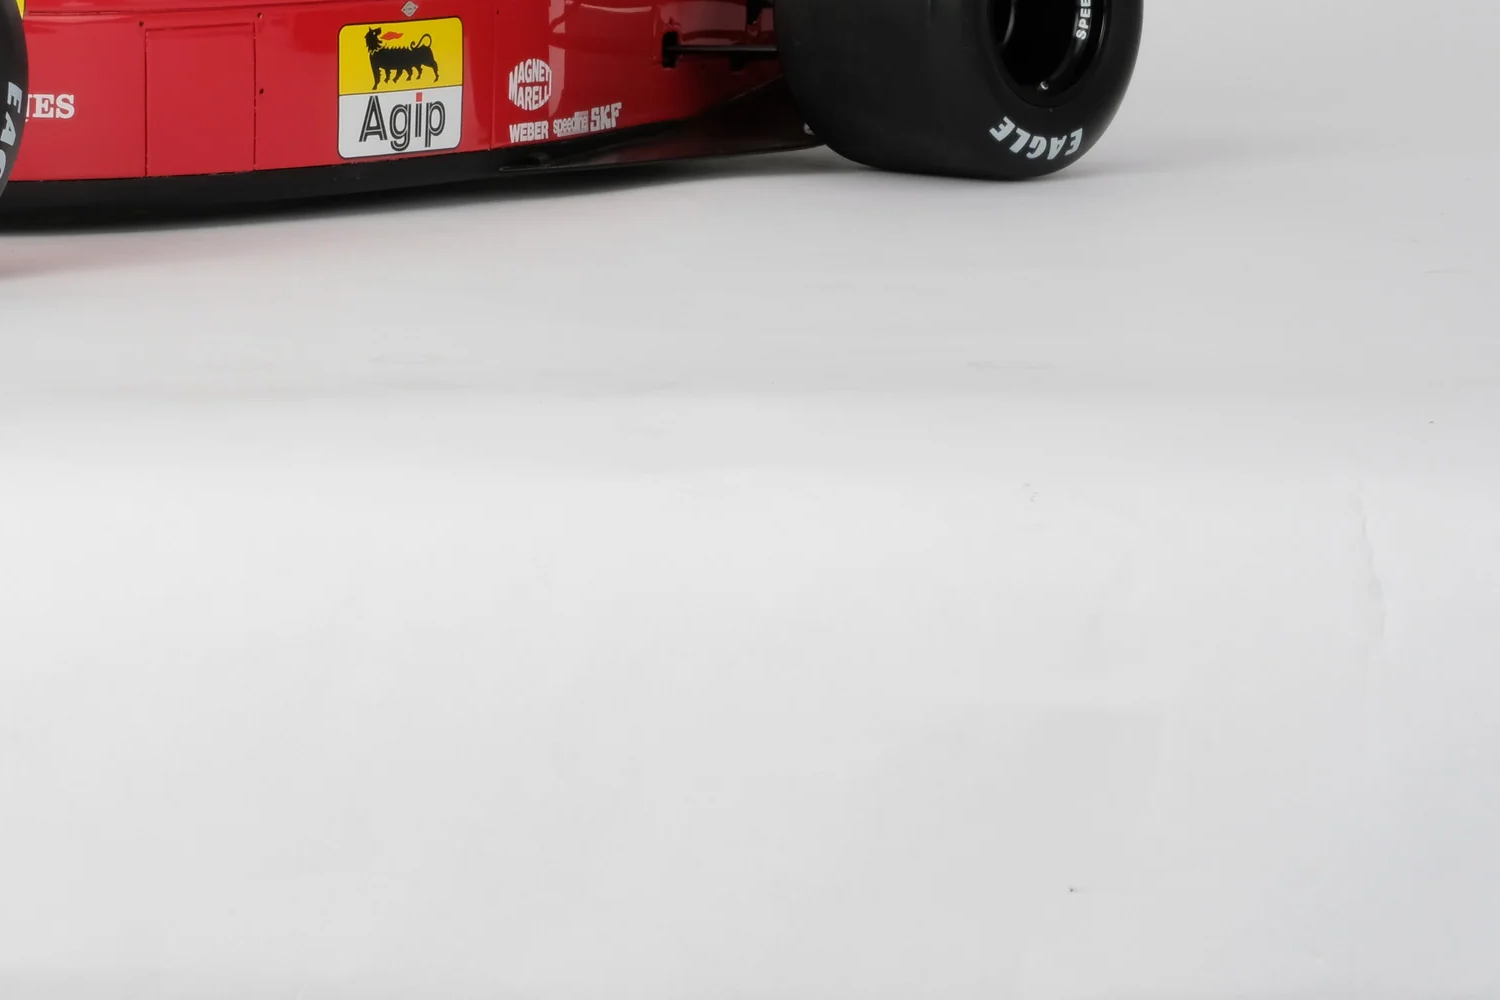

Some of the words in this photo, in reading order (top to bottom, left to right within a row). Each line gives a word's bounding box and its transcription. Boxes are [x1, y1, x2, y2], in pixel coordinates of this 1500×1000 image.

[358, 92, 446, 151] Agip
[509, 121, 549, 144] WEBER
[590, 102, 623, 133] SKF
[989, 116, 1083, 160] EAGLE
